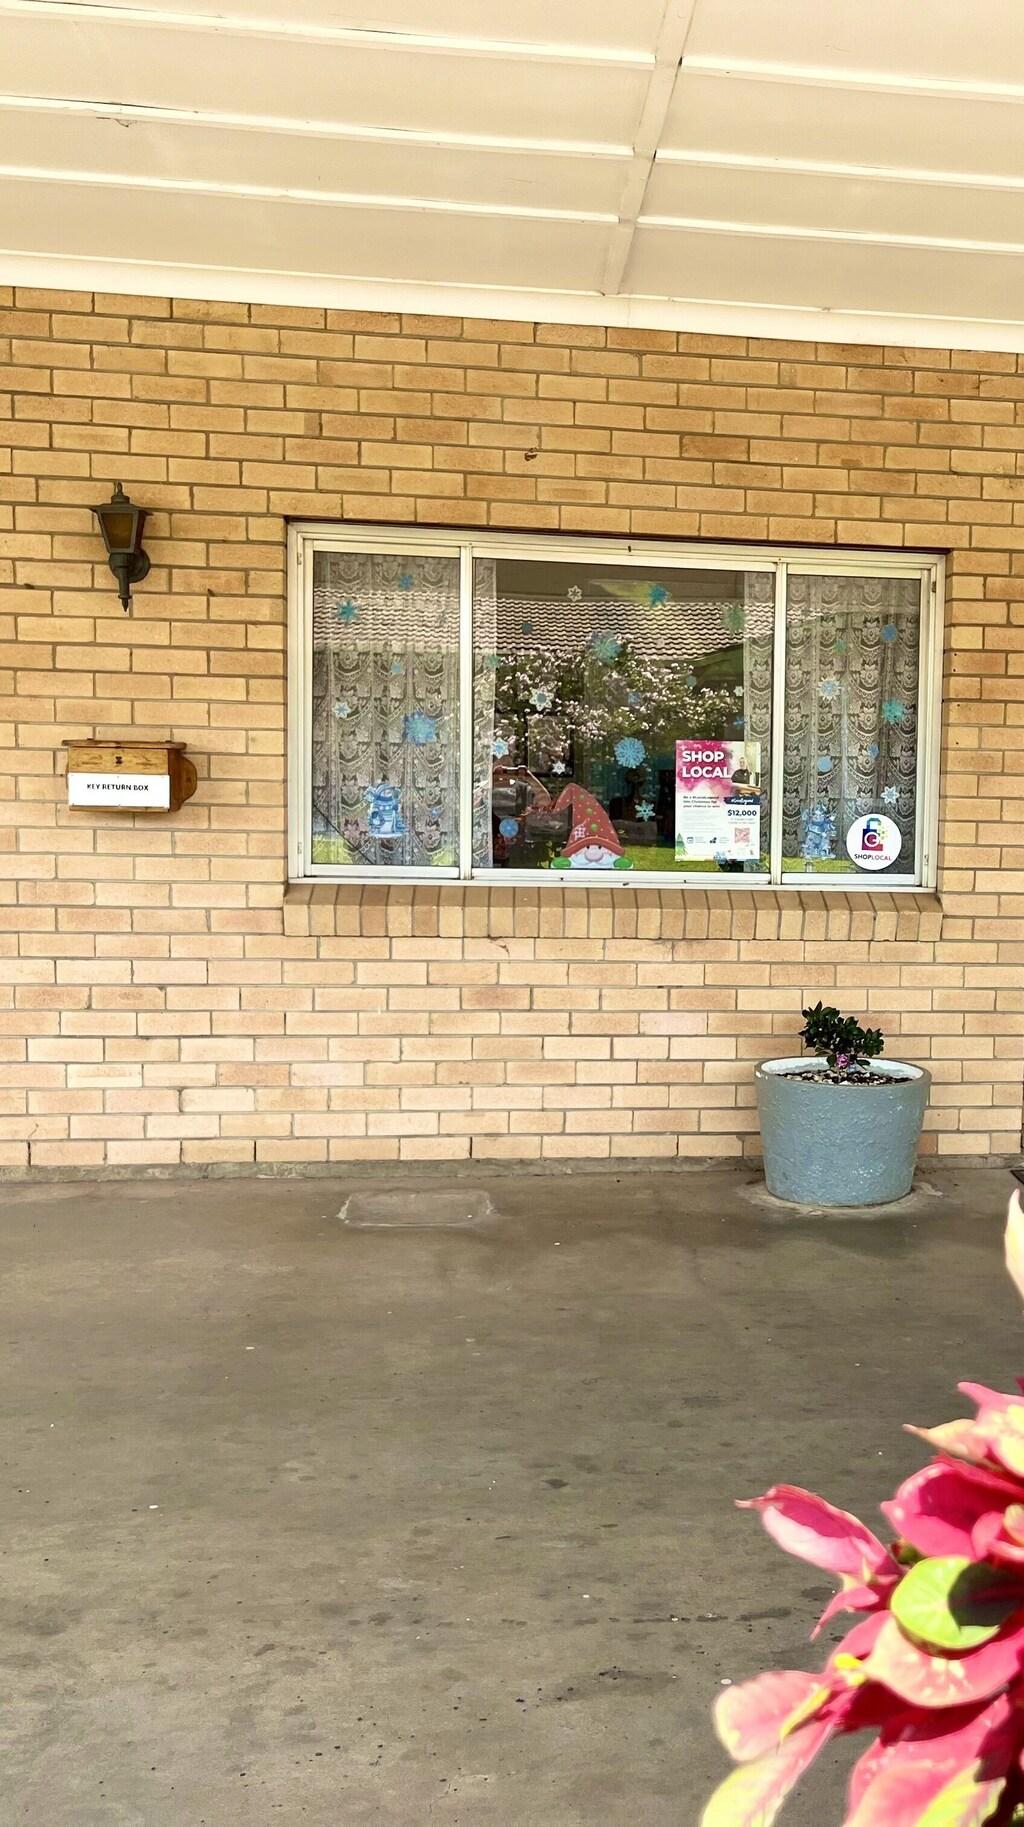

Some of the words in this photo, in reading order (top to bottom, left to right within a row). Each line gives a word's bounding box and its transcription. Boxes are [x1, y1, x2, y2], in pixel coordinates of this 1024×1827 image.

[682, 750, 725, 763] SHOP
[682, 766, 731, 778] LOCAL
[102, 783, 132, 791] RETURN
[727, 809, 757, 817] $12,000
